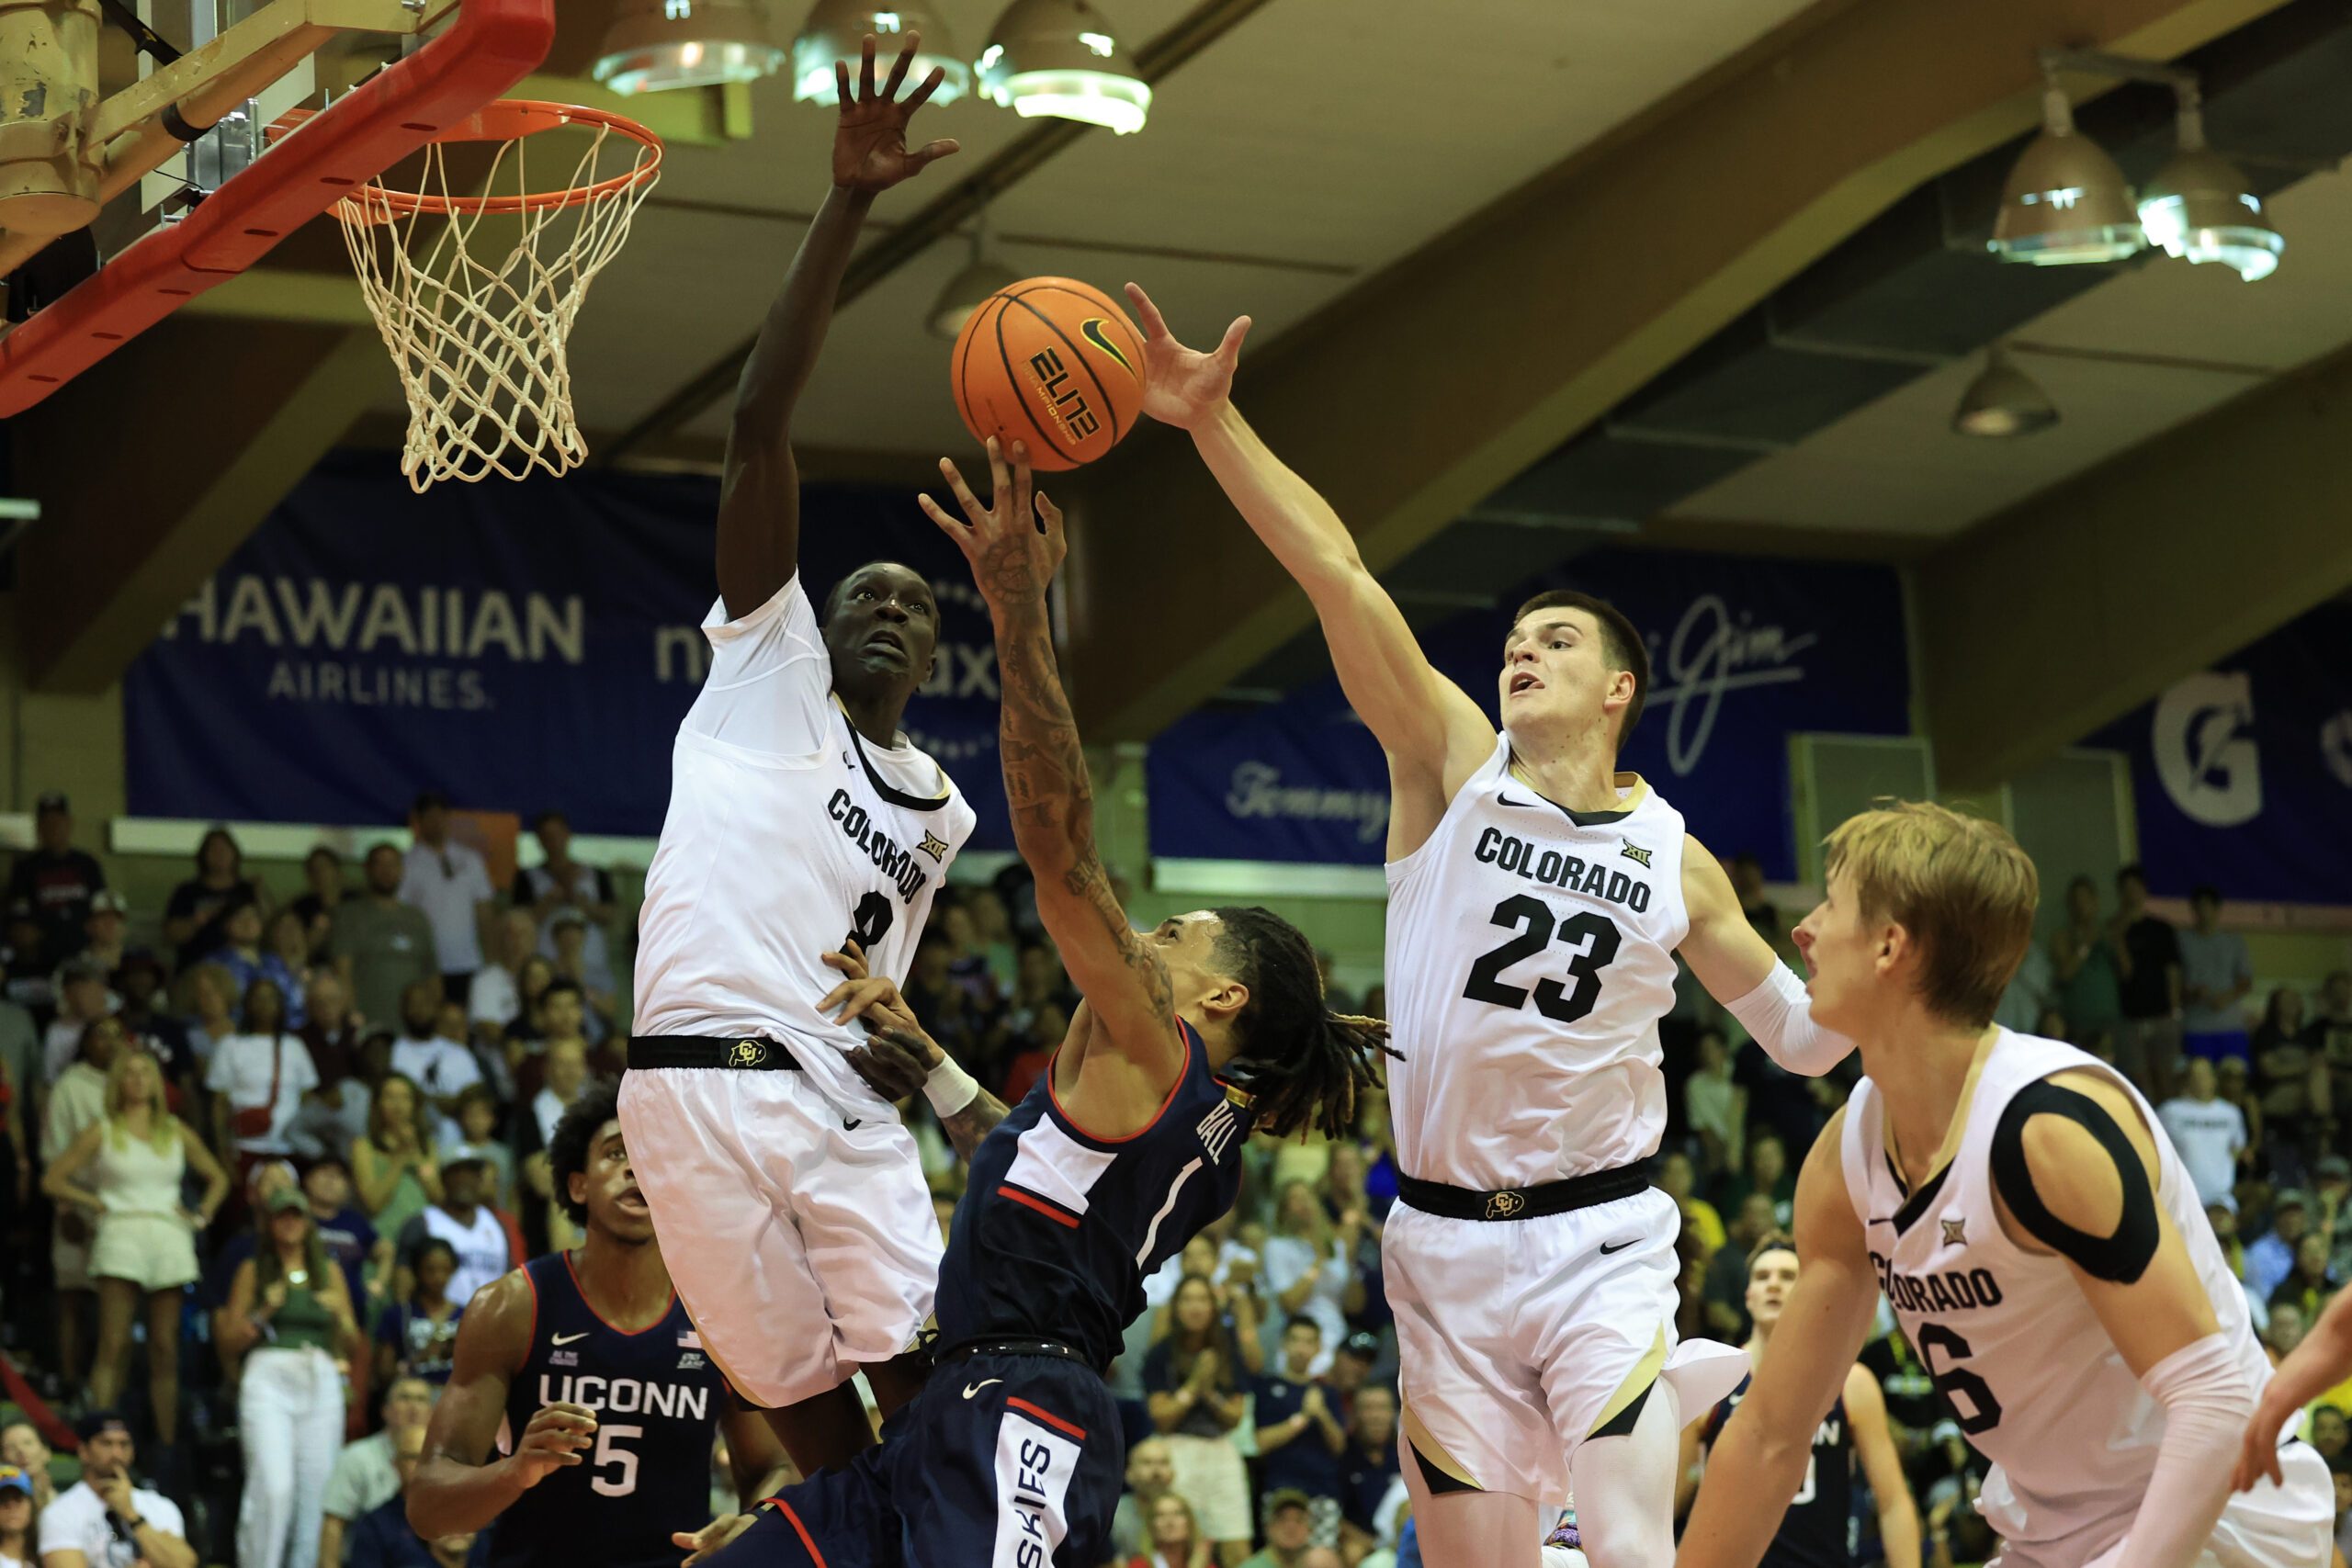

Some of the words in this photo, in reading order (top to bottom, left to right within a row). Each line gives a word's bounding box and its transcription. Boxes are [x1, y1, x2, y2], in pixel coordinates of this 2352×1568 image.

[1029, 344, 1102, 441] ELITE
[162, 575, 583, 665] HAWAIIAN
[2152, 671, 2261, 827] G
[1474, 826, 1652, 914] COLORADO
[1462, 893, 1623, 1023] 23
[1196, 1097, 1238, 1166] BALL
[1135, 1156, 1204, 1271] 1
[538, 1373, 708, 1421] UCONN
[1917, 1322, 2003, 1436] 6
[591, 1424, 644, 1497] 5
